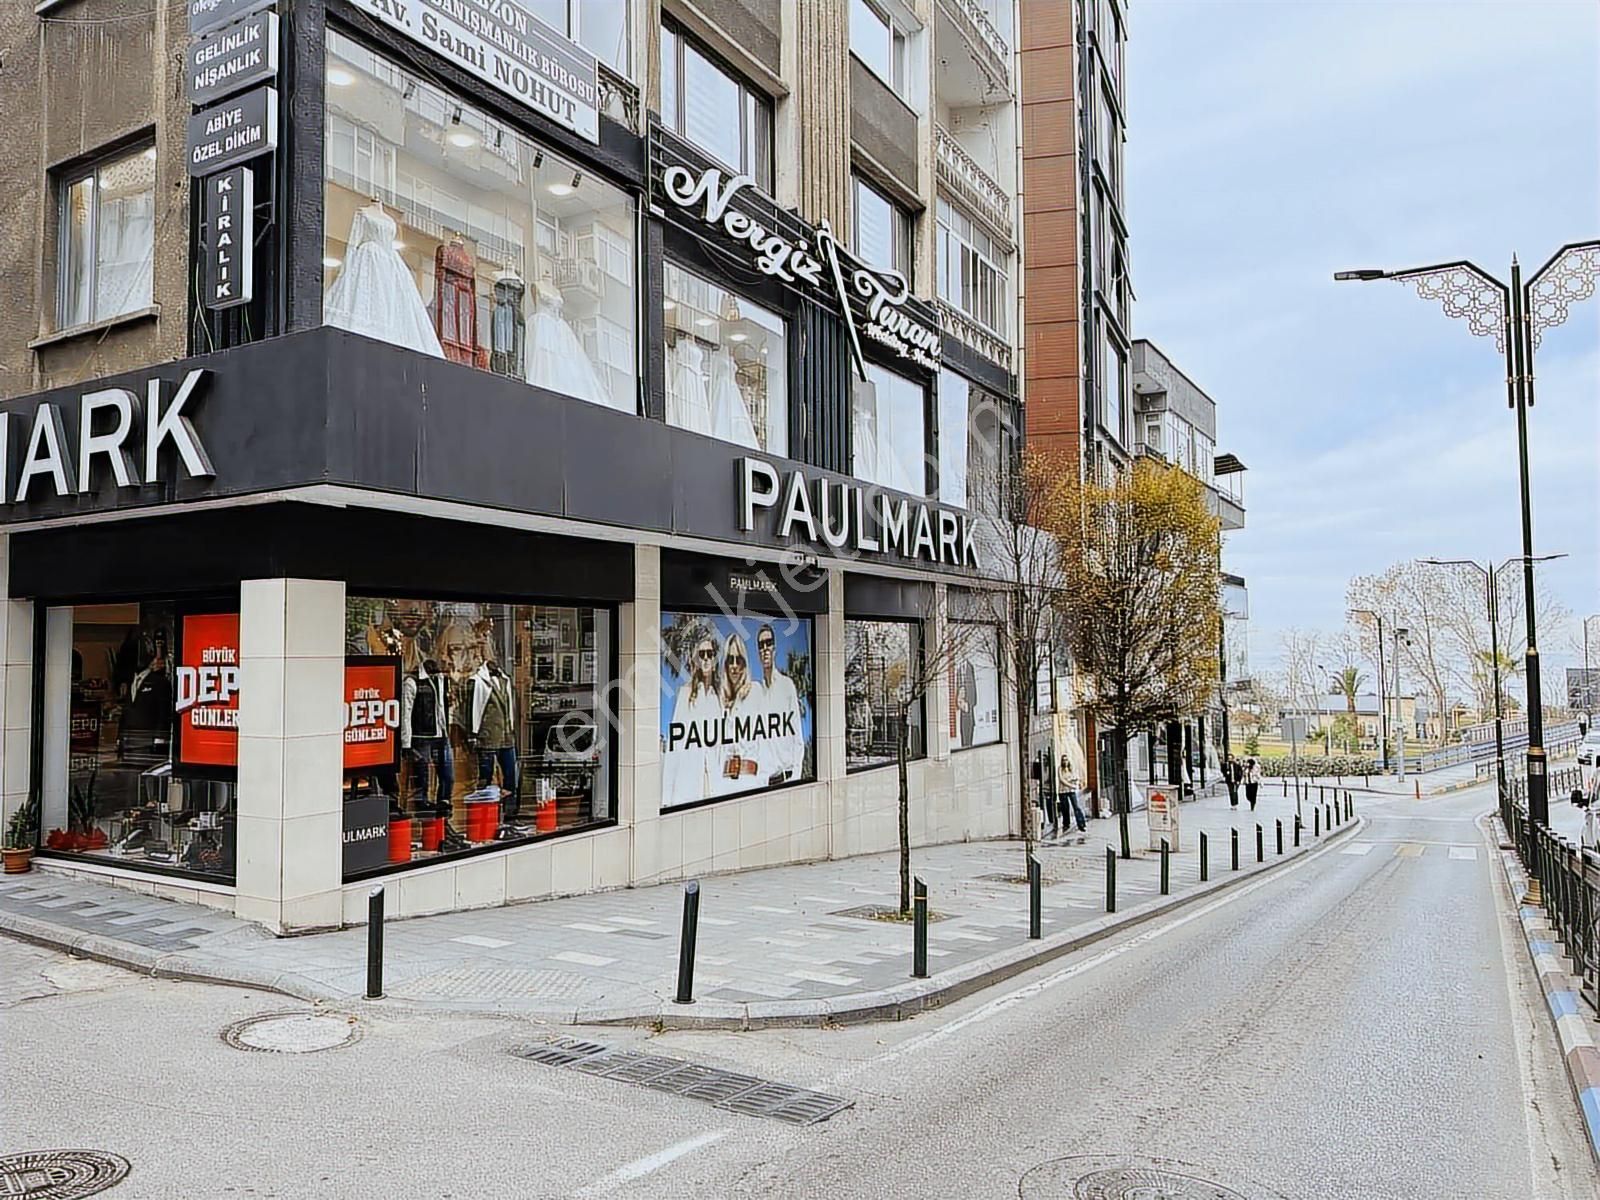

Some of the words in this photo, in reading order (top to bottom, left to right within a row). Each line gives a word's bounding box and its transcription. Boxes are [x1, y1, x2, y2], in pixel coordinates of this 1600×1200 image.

[195, 24, 261, 65] GELİNLİK
[430, 0, 540, 68] ANIŞMANLIK
[541, 55, 594, 102] BÜROSU
[194, 48, 261, 90] NİŞANLIK
[421, 11, 486, 72] Sami
[494, 54, 576, 123] NOHUT
[205, 108, 242, 136] ABİYE
[192, 141, 223, 164] ÖZEL
[225, 125, 261, 152] DİKİM
[664, 165, 822, 287] Nergiz
[855, 268, 942, 357] Turan
[735, 456, 981, 569] PAULMARK
[730, 577, 778, 592] PAULMARK
[202, 646, 236, 663] BÜYÜK
[345, 725, 387, 743] GÜNLERİ
[669, 711, 796, 752] PAULMARK
